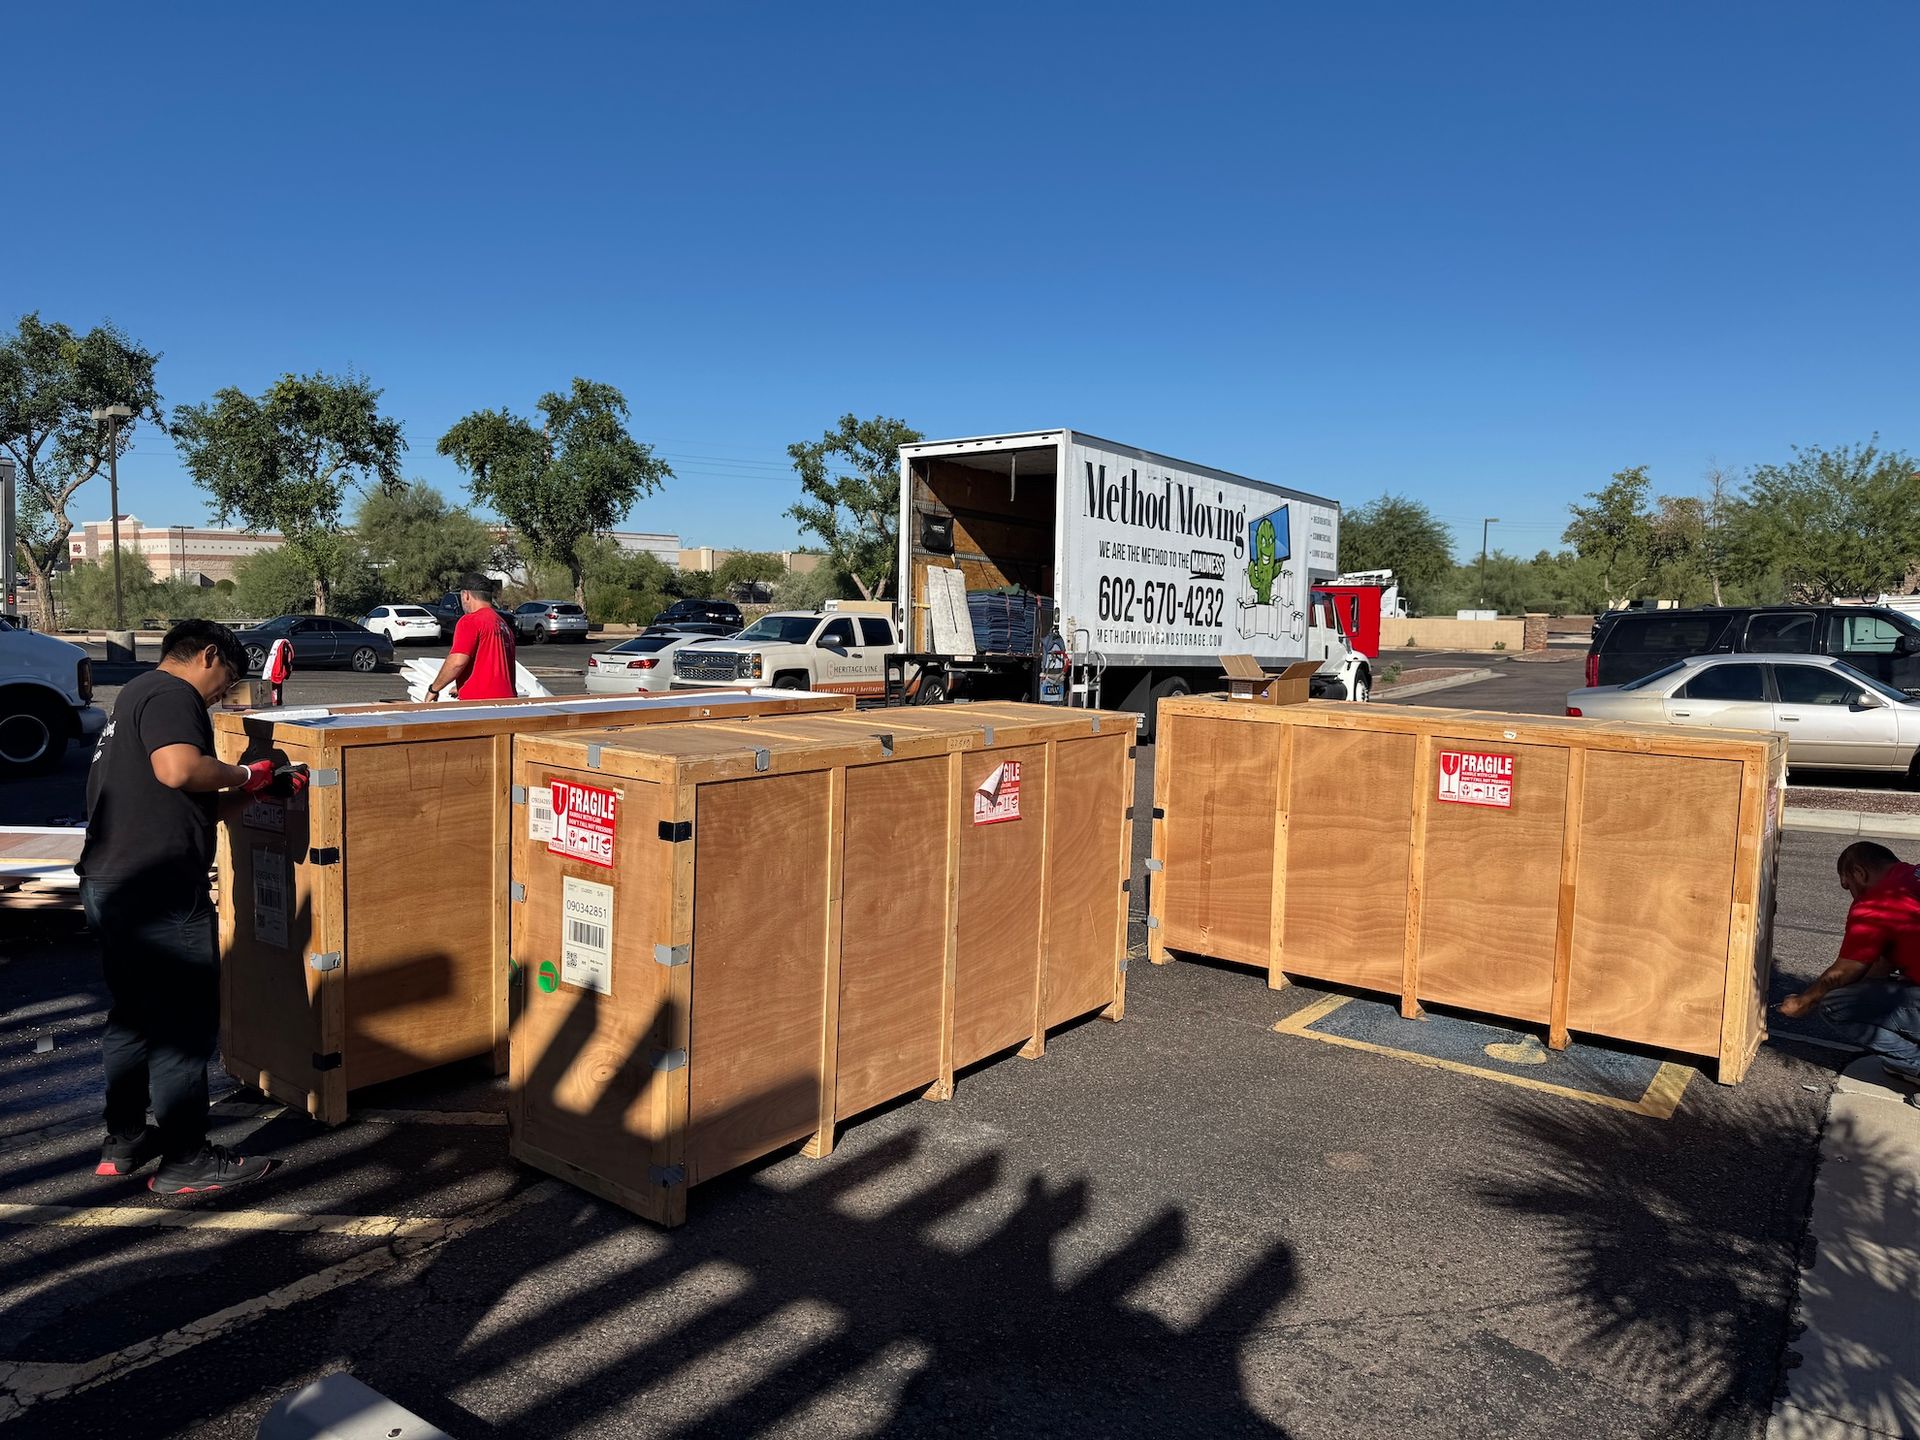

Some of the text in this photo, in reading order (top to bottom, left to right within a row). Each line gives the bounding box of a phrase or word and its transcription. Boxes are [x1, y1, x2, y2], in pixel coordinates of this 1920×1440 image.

[1083, 461, 1245, 559] Method Moving
[1099, 540, 1225, 577] WE ARE THE METHOD TO THE MADNESS
[1099, 575, 1223, 627] 602-670-4232
[834, 665, 862, 673] HERITAGE
[1003, 763, 1020, 783] GILE
[1462, 754, 1512, 775] FRAGILE
[570, 787, 615, 820] FRAGILE
[567, 900, 606, 918] 090342851
